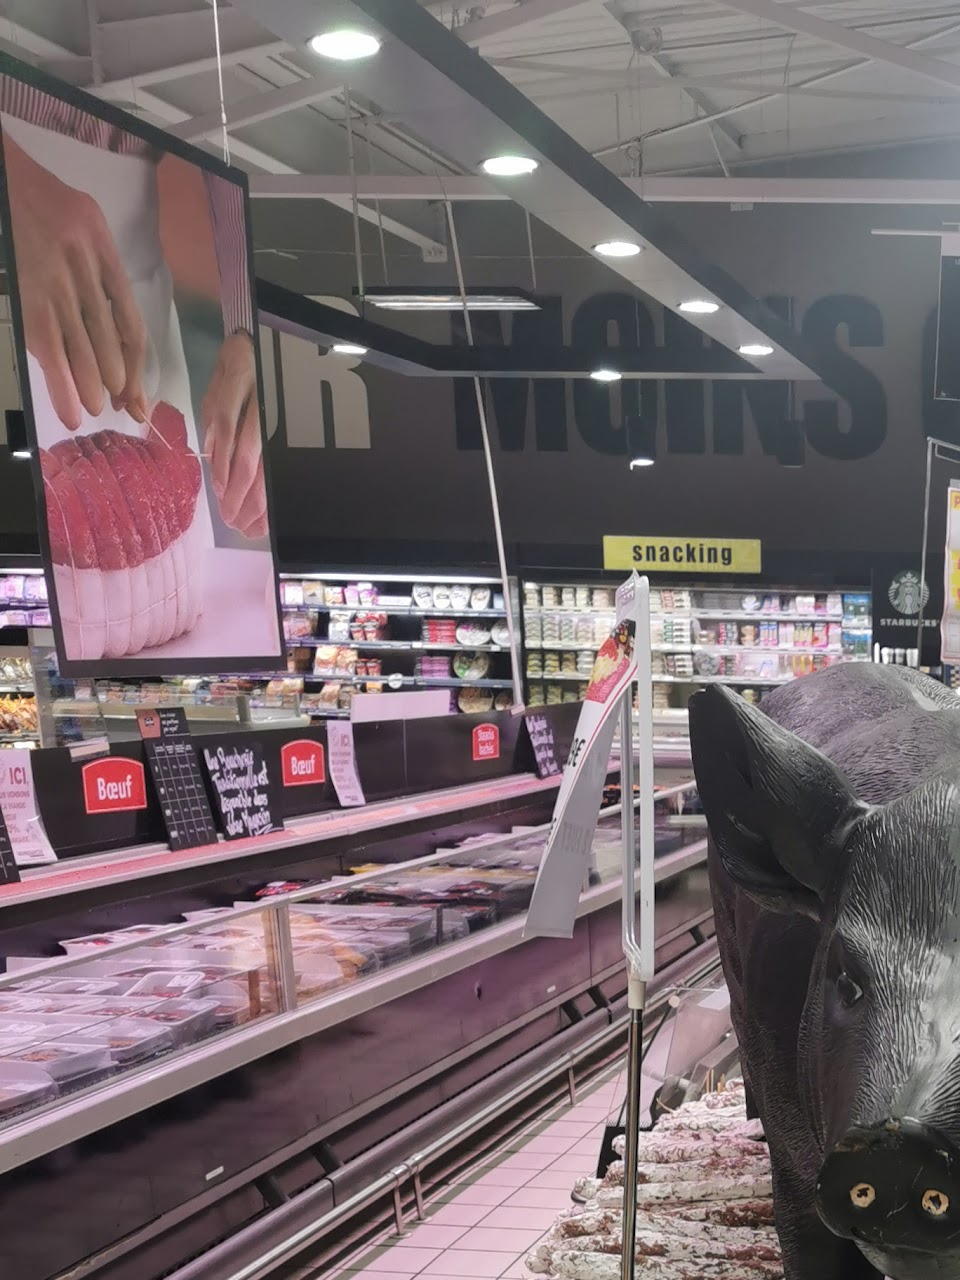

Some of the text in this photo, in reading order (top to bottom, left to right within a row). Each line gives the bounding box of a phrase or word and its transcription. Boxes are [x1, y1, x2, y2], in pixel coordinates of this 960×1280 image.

[632, 543, 733, 566] snacking
[291, 753, 316, 776] Bœuf
[96, 774, 133, 801] Bœuf
